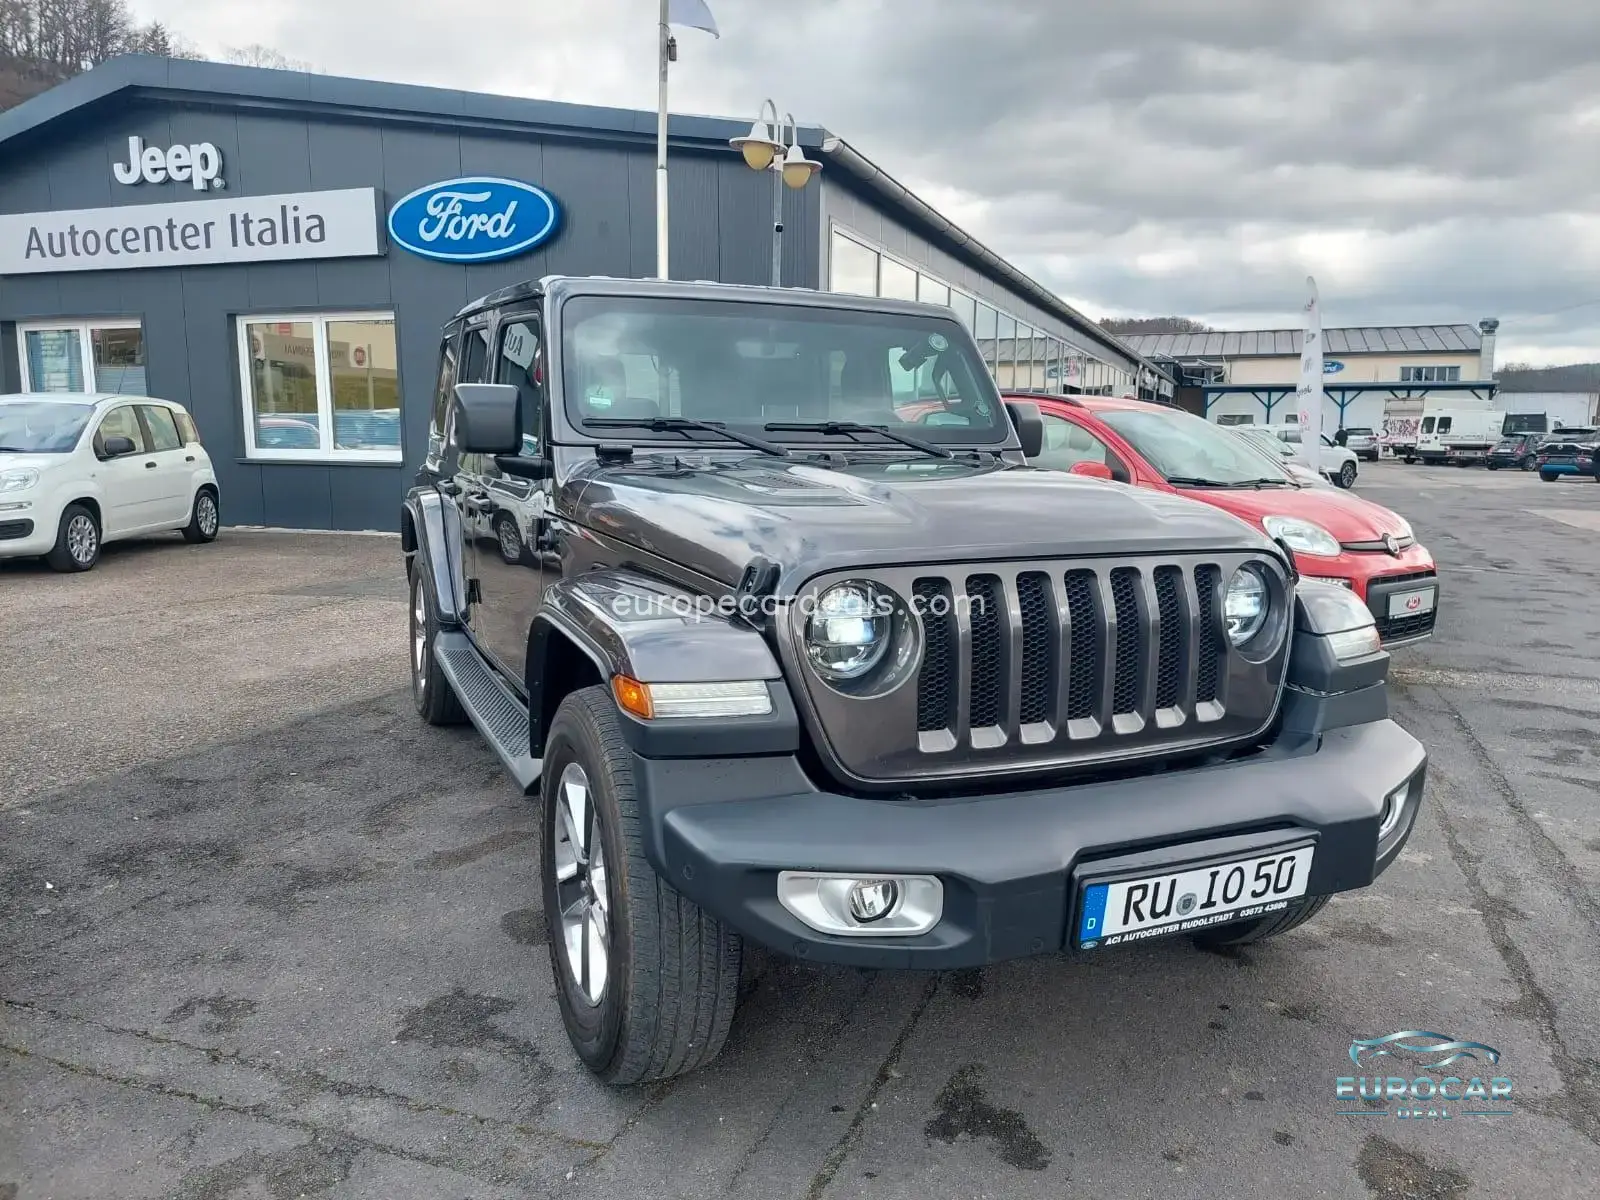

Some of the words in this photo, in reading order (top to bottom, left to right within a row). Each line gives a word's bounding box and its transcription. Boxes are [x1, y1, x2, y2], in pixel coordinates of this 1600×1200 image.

[113, 136, 222, 190] Jeep
[24, 218, 216, 259] Autocenter
[230, 204, 327, 248] Italia
[418, 191, 519, 242] Ford
[1087, 918, 1096, 929] D
[1122, 878, 1177, 926] RU
[1104, 934, 1122, 946] ACI
[1122, 923, 1179, 942] AUTOCENTER
[1180, 912, 1235, 930] RUDOLSTADT
